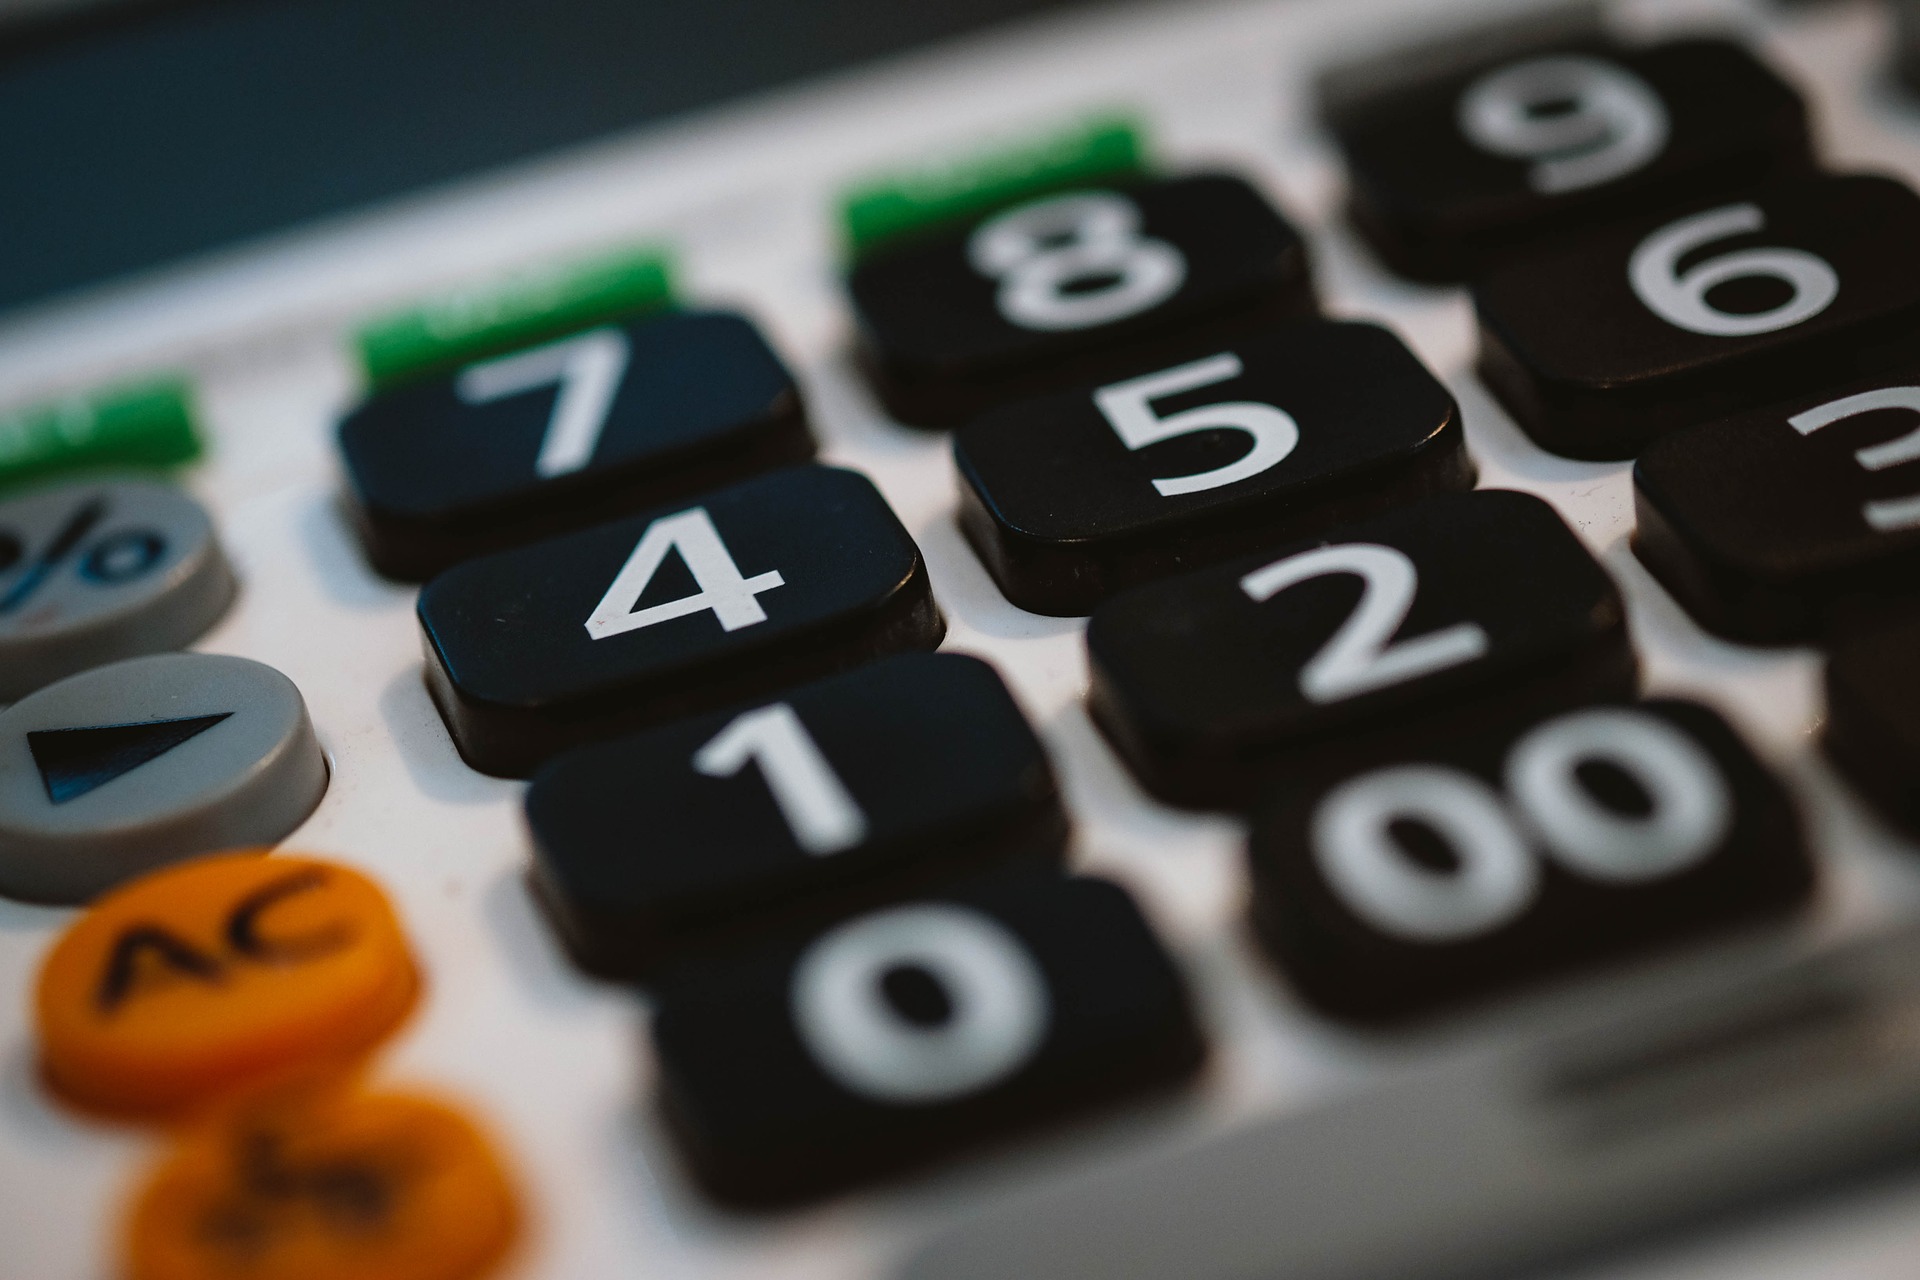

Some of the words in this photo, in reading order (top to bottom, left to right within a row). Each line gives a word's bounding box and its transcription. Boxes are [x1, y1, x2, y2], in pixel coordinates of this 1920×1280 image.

[1461, 58, 1668, 192] 9
[969, 190, 1187, 331] 8
[1628, 204, 1839, 337] 6
[457, 325, 631, 478] 7
[1093, 353, 1300, 497] 5
[1786, 385, 1920, 530] 3
[583, 506, 786, 641] 4
[1240, 542, 1488, 702] 2
[693, 702, 865, 854] 1
[1311, 708, 1729, 940] 00
[94, 862, 362, 1018] AC
[792, 904, 1047, 1100] 0
